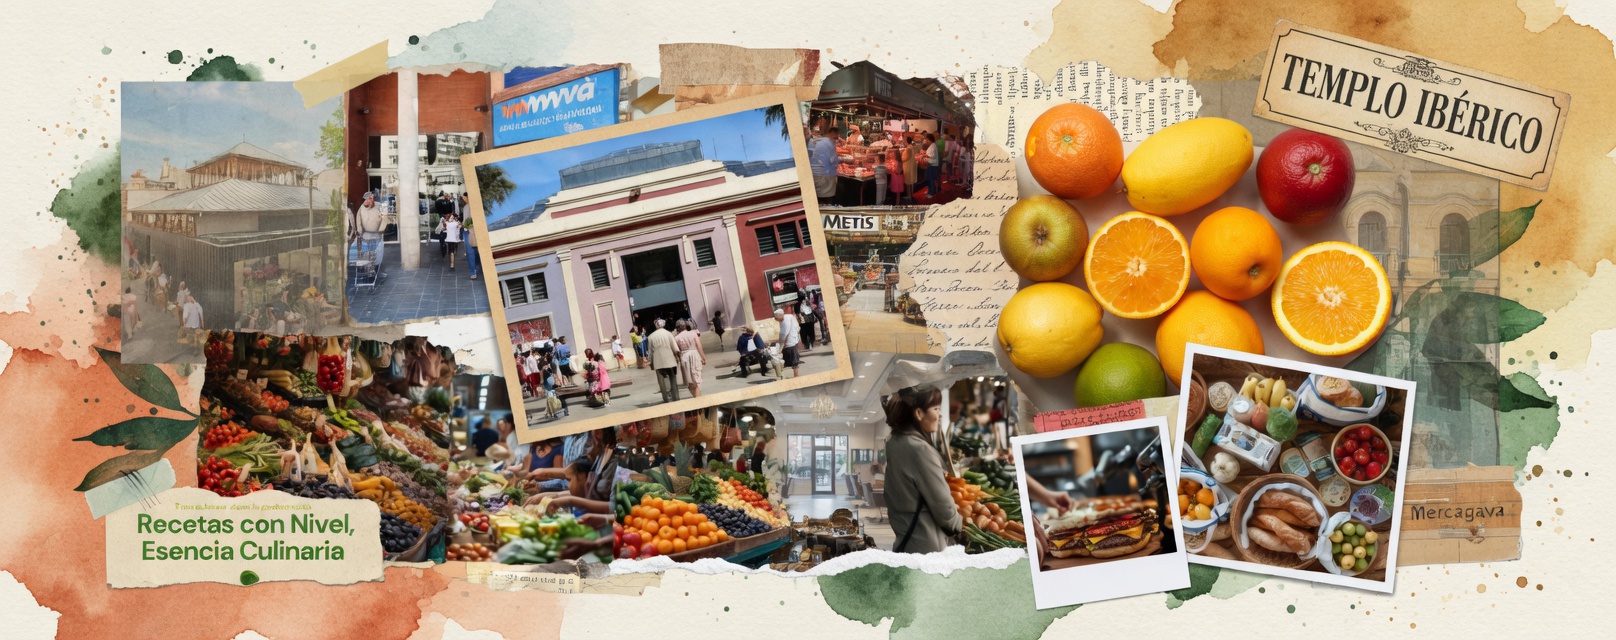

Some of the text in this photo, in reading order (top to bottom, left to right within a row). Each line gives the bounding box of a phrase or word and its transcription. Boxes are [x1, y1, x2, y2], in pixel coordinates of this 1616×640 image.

[1281, 53, 1543, 154] TEMPLO IBÉRICO
[823, 214, 874, 230] METIS
[1411, 505, 1504, 522] Mercagava
[137, 513, 355, 536] Recetas con Nivel,
[142, 540, 345, 561] Esencia Culinaria
